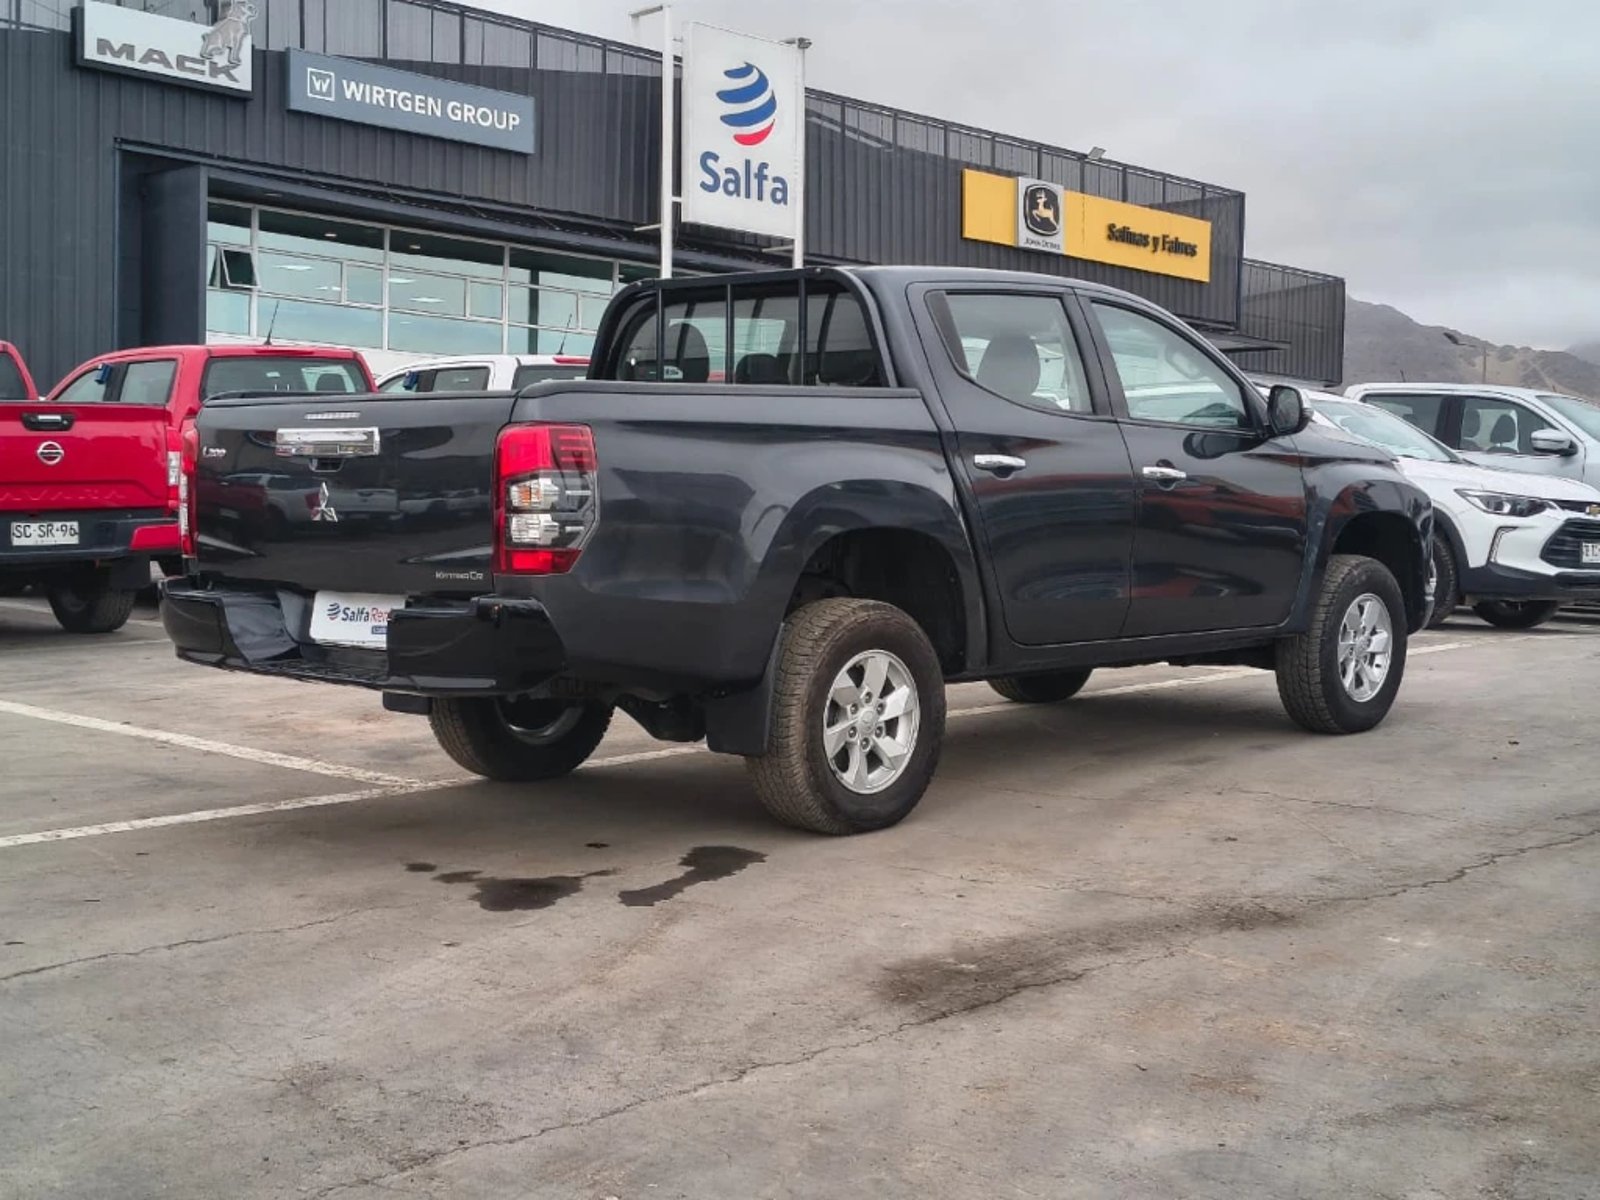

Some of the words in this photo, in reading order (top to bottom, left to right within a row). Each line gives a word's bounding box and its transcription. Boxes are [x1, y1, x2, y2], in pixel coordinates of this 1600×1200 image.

[97, 37, 240, 83] MACK
[342, 79, 442, 117] WIRTGEN
[447, 101, 520, 130] GROUP
[700, 151, 788, 206] Salfa
[1107, 223, 1150, 248] Salinas
[1152, 235, 1161, 253] y
